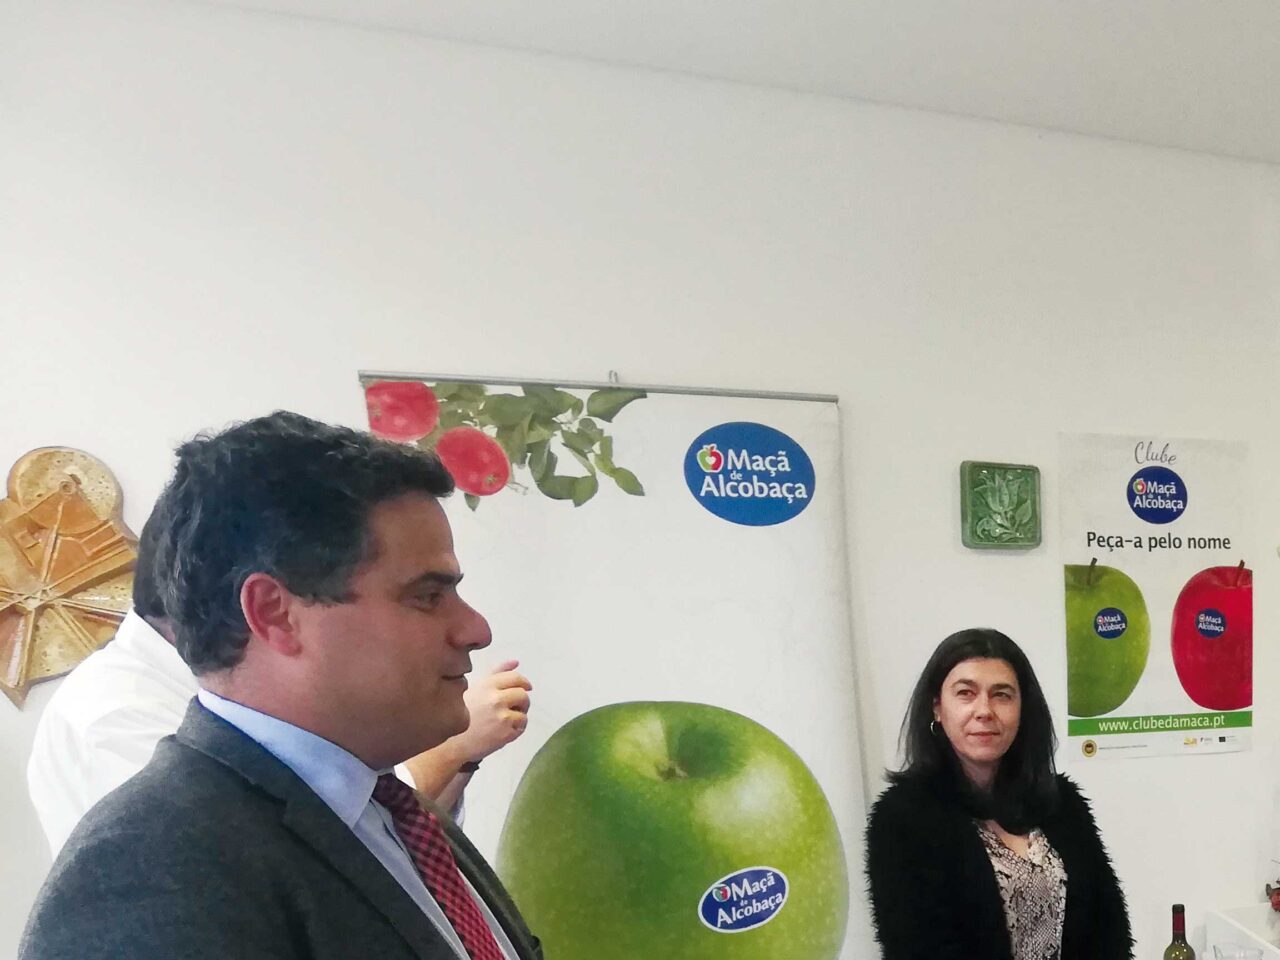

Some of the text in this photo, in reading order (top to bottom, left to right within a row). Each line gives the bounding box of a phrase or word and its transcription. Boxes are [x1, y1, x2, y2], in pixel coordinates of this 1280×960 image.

[727, 449, 791, 477] Maçã
[1134, 441, 1177, 465] Clube
[730, 471, 742, 480] de
[700, 475, 808, 504] Alcobaça
[1146, 481, 1176, 497] Maçã
[1133, 495, 1184, 512] Alcobaça
[1087, 531, 1231, 552] Peça-a pelo nome
[1099, 714, 1225, 732] www.clubedamaca.pt
[731, 872, 776, 901] Maçã
[717, 892, 783, 928] Alcobaça
